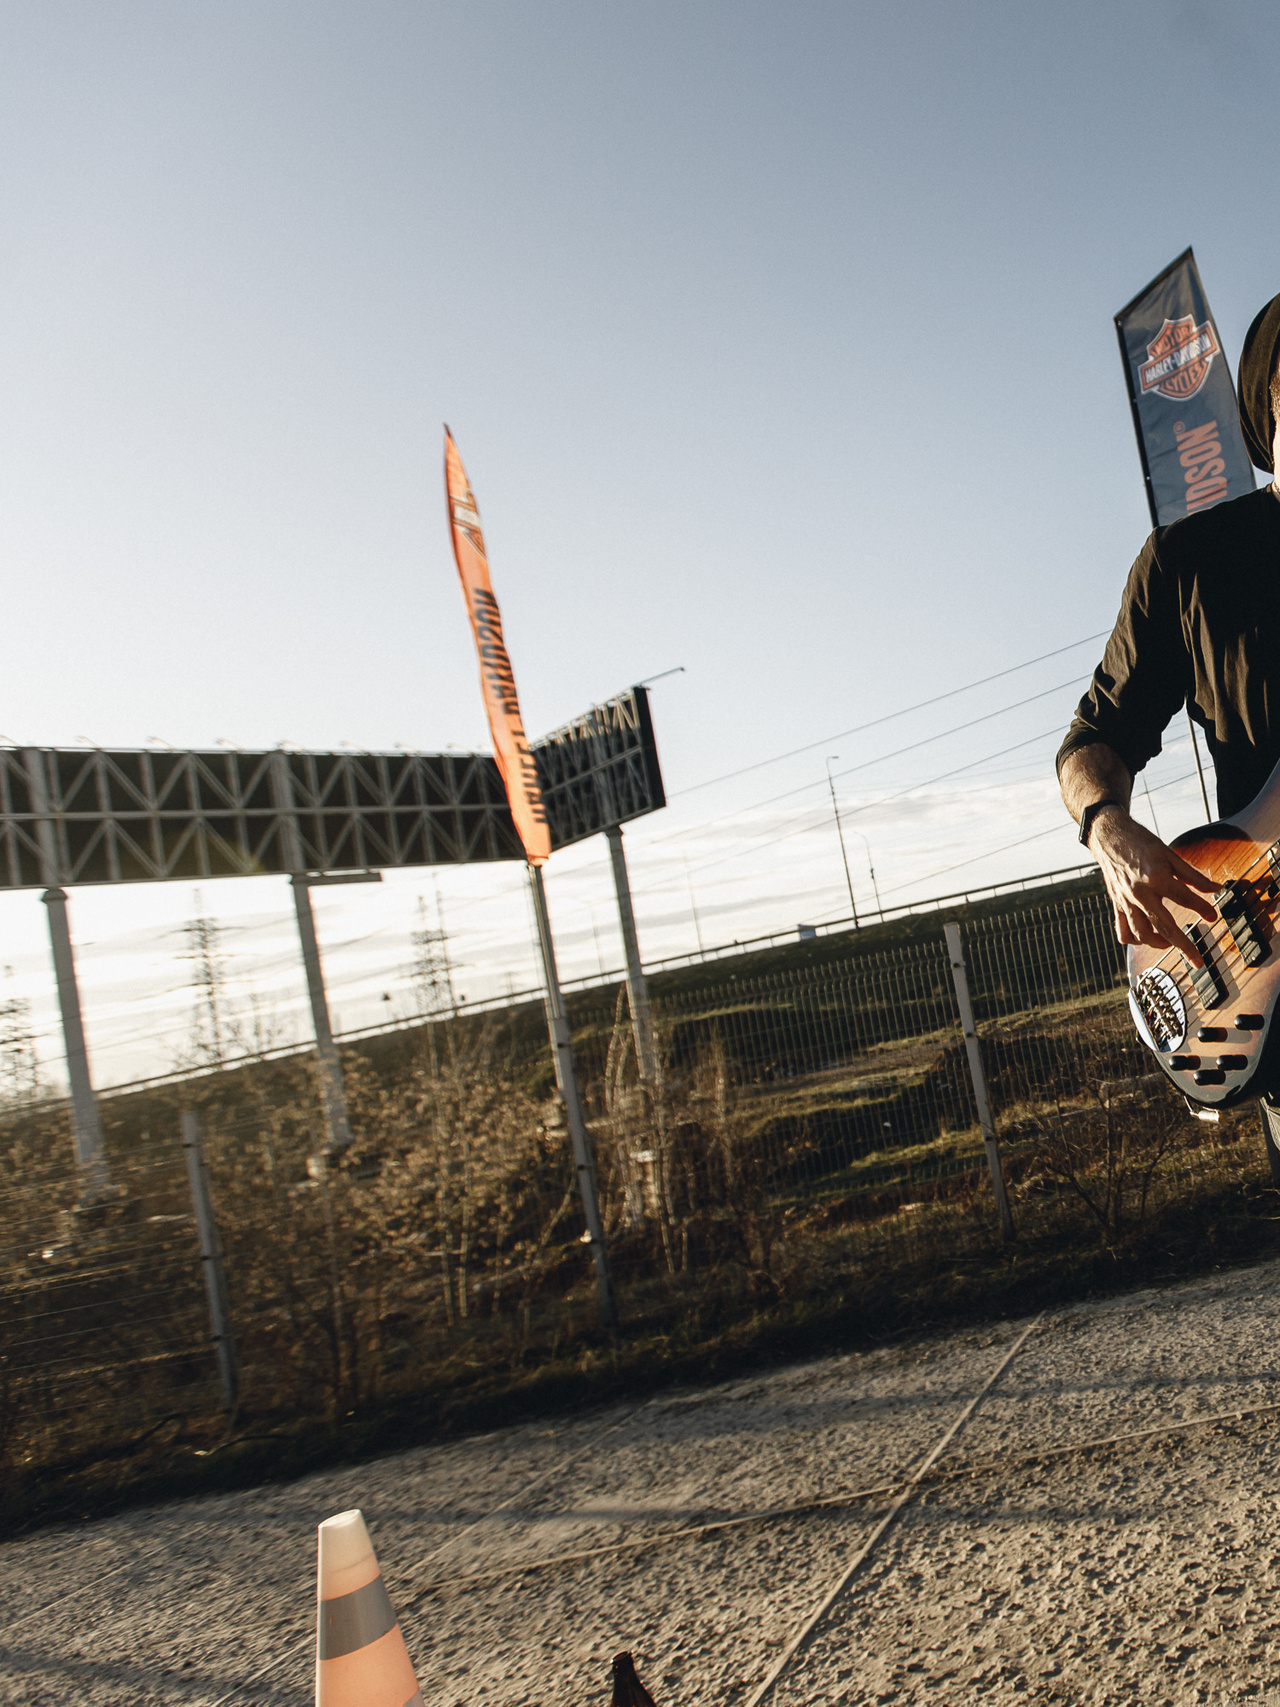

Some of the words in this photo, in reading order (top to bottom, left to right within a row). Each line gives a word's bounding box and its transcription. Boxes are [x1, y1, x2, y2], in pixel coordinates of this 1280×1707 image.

[1145, 332, 1213, 384] HARLEY-DAVIDSON
[1154, 325, 1191, 358] MOTOR
[1165, 362, 1204, 392] CYCLES
[1176, 420, 1228, 516] IDSON
